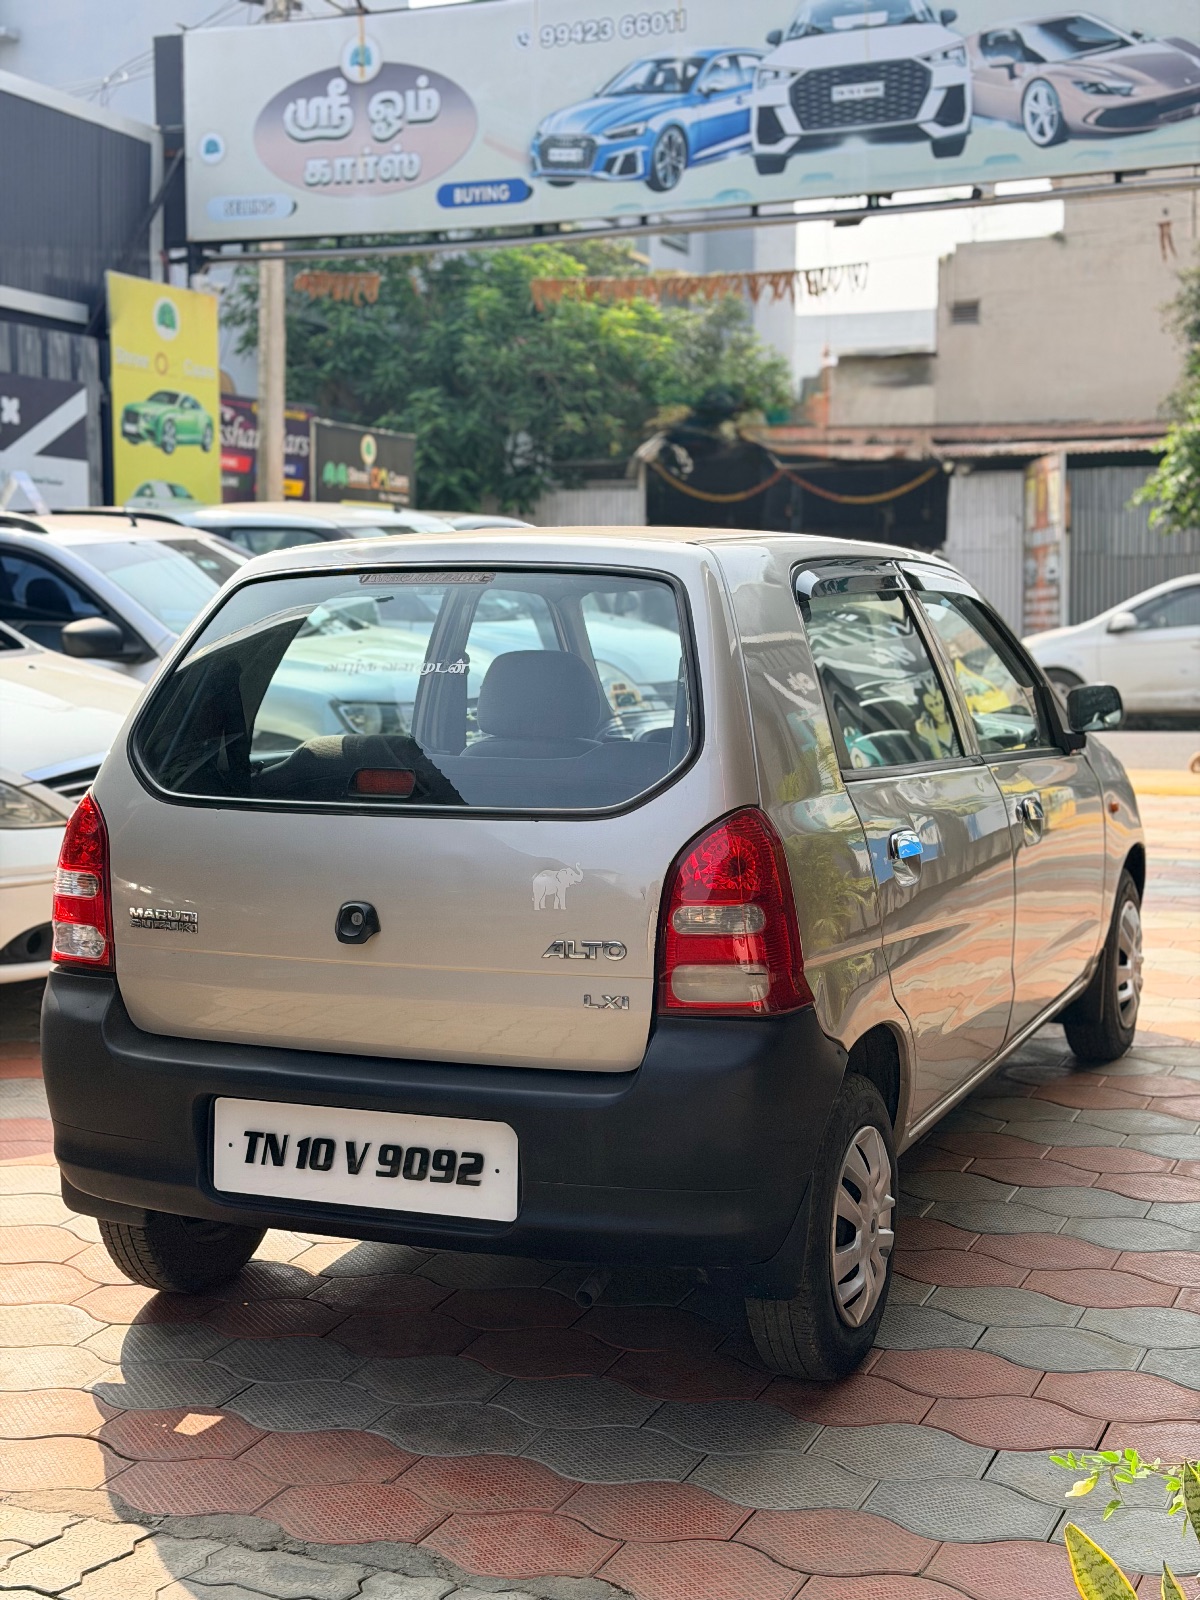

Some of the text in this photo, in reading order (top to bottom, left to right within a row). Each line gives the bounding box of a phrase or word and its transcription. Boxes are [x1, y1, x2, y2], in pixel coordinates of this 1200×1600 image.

[540, 9, 688, 49] 99423 66011
[304, 144, 422, 187] கார்ஸ்
[453, 184, 510, 204] BUYING
[129, 907, 198, 923] MARUTI
[130, 918, 198, 934] SUZUKI
[541, 940, 627, 961] ALTO
[244, 1130, 485, 1187] TN 10 V 9092
